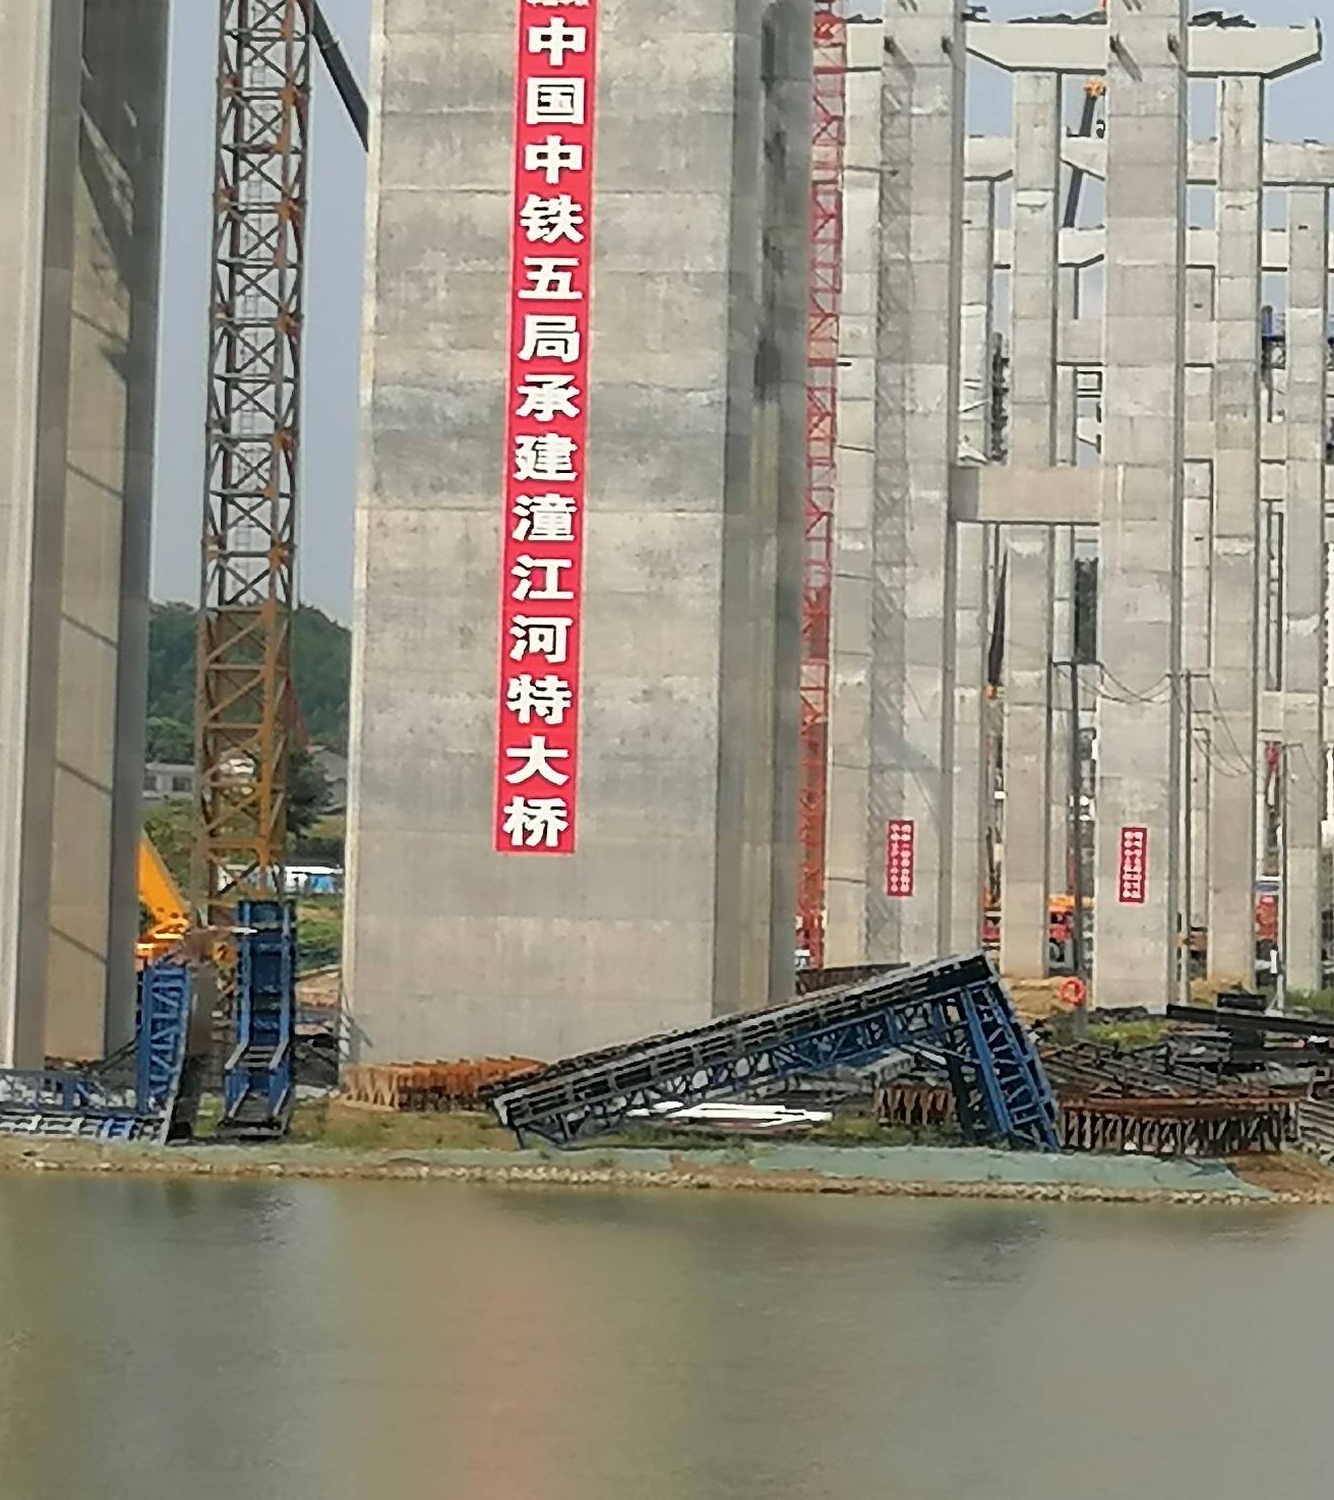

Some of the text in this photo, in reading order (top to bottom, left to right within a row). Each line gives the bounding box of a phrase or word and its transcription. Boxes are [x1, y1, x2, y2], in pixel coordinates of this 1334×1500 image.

[503, 16, 587, 848] 中国中铁五局承建潼江河特大桥
